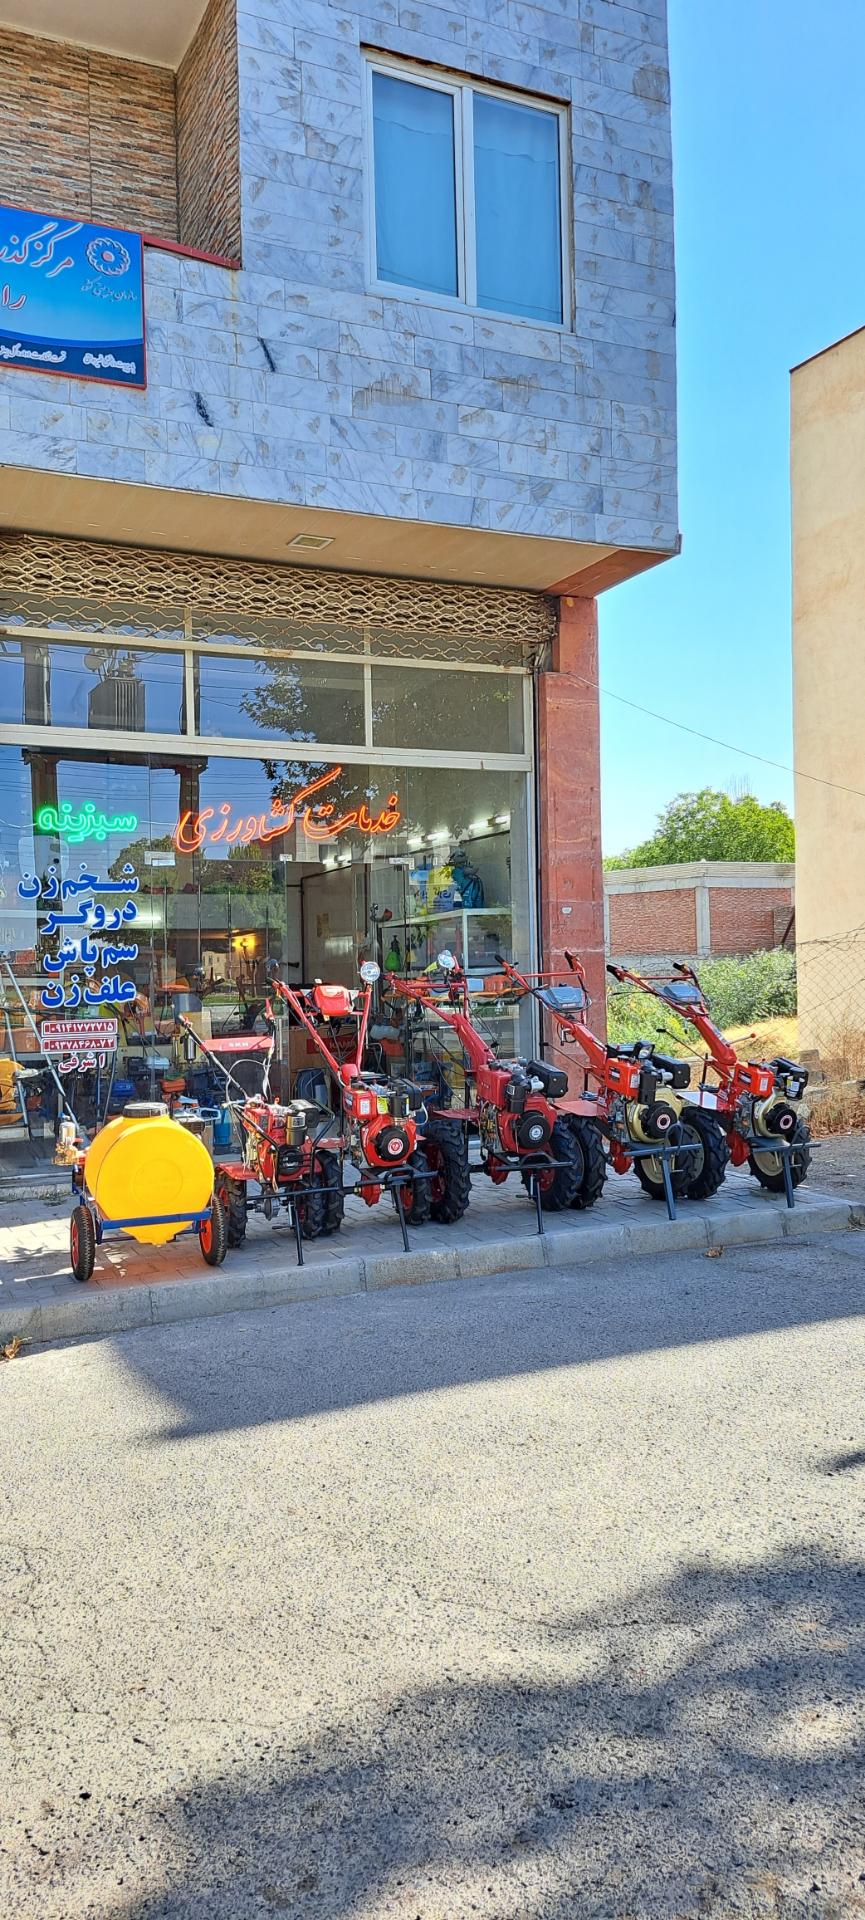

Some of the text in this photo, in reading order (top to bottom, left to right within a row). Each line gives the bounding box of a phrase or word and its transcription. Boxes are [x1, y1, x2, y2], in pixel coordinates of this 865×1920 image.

[30, 222, 83, 278] مرکز
[38, 803, 138, 842] سبزینه
[175, 766, 401, 853] خدمات کشاورزی
[17, 862, 139, 901] شخم زن
[40, 898, 138, 934] دروگر
[43, 935, 138, 977] سم پاش
[41, 974, 137, 1008] علف زن
[58, 1051, 106, 1073] اشرفی
